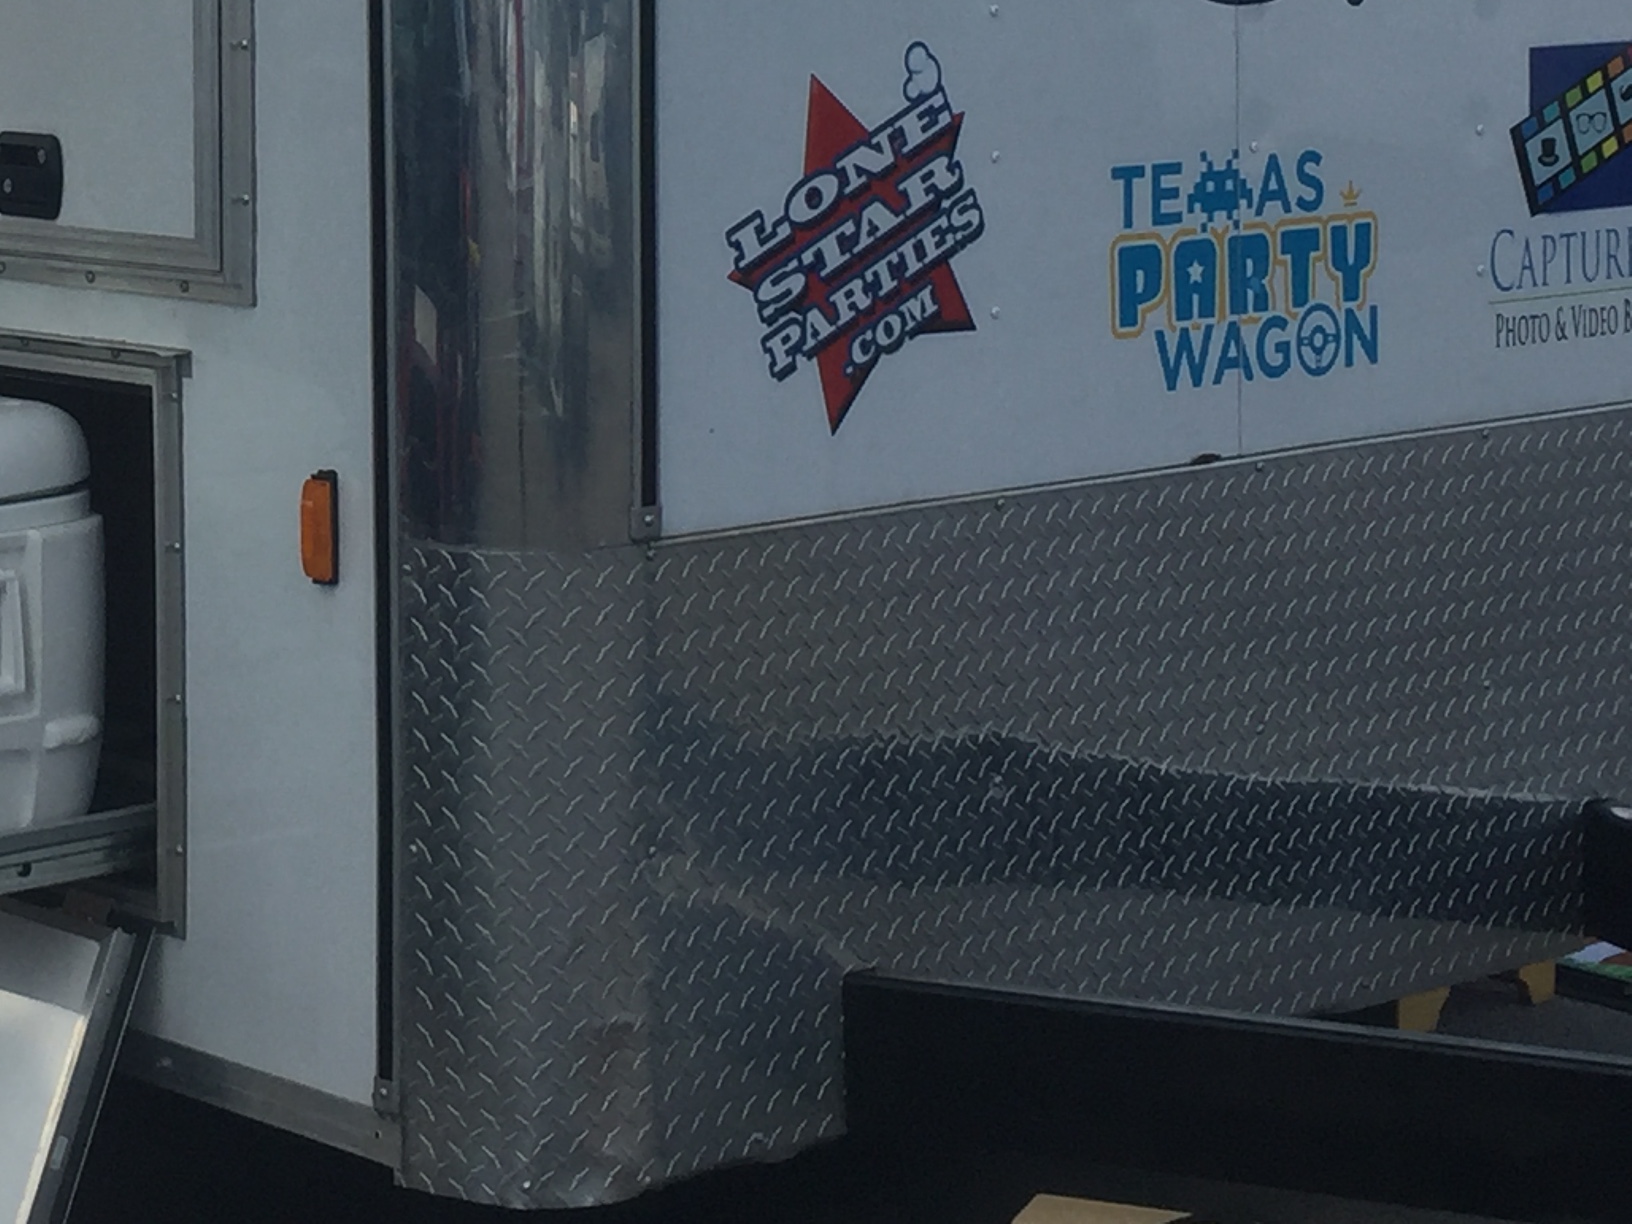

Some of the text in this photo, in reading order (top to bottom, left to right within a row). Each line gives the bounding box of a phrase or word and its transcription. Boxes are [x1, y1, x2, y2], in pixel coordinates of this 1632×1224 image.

[728, 88, 954, 271] LONE
[754, 155, 963, 320] STAR
[765, 191, 984, 379] PARTIES
[1115, 219, 1374, 331] PARTY
[845, 283, 940, 376] .COM
[1154, 303, 1379, 392] WAGON
[1495, 313, 1551, 349] PHOTO
[1554, 305, 1569, 342] &
[1570, 304, 1619, 339] VIDEO
